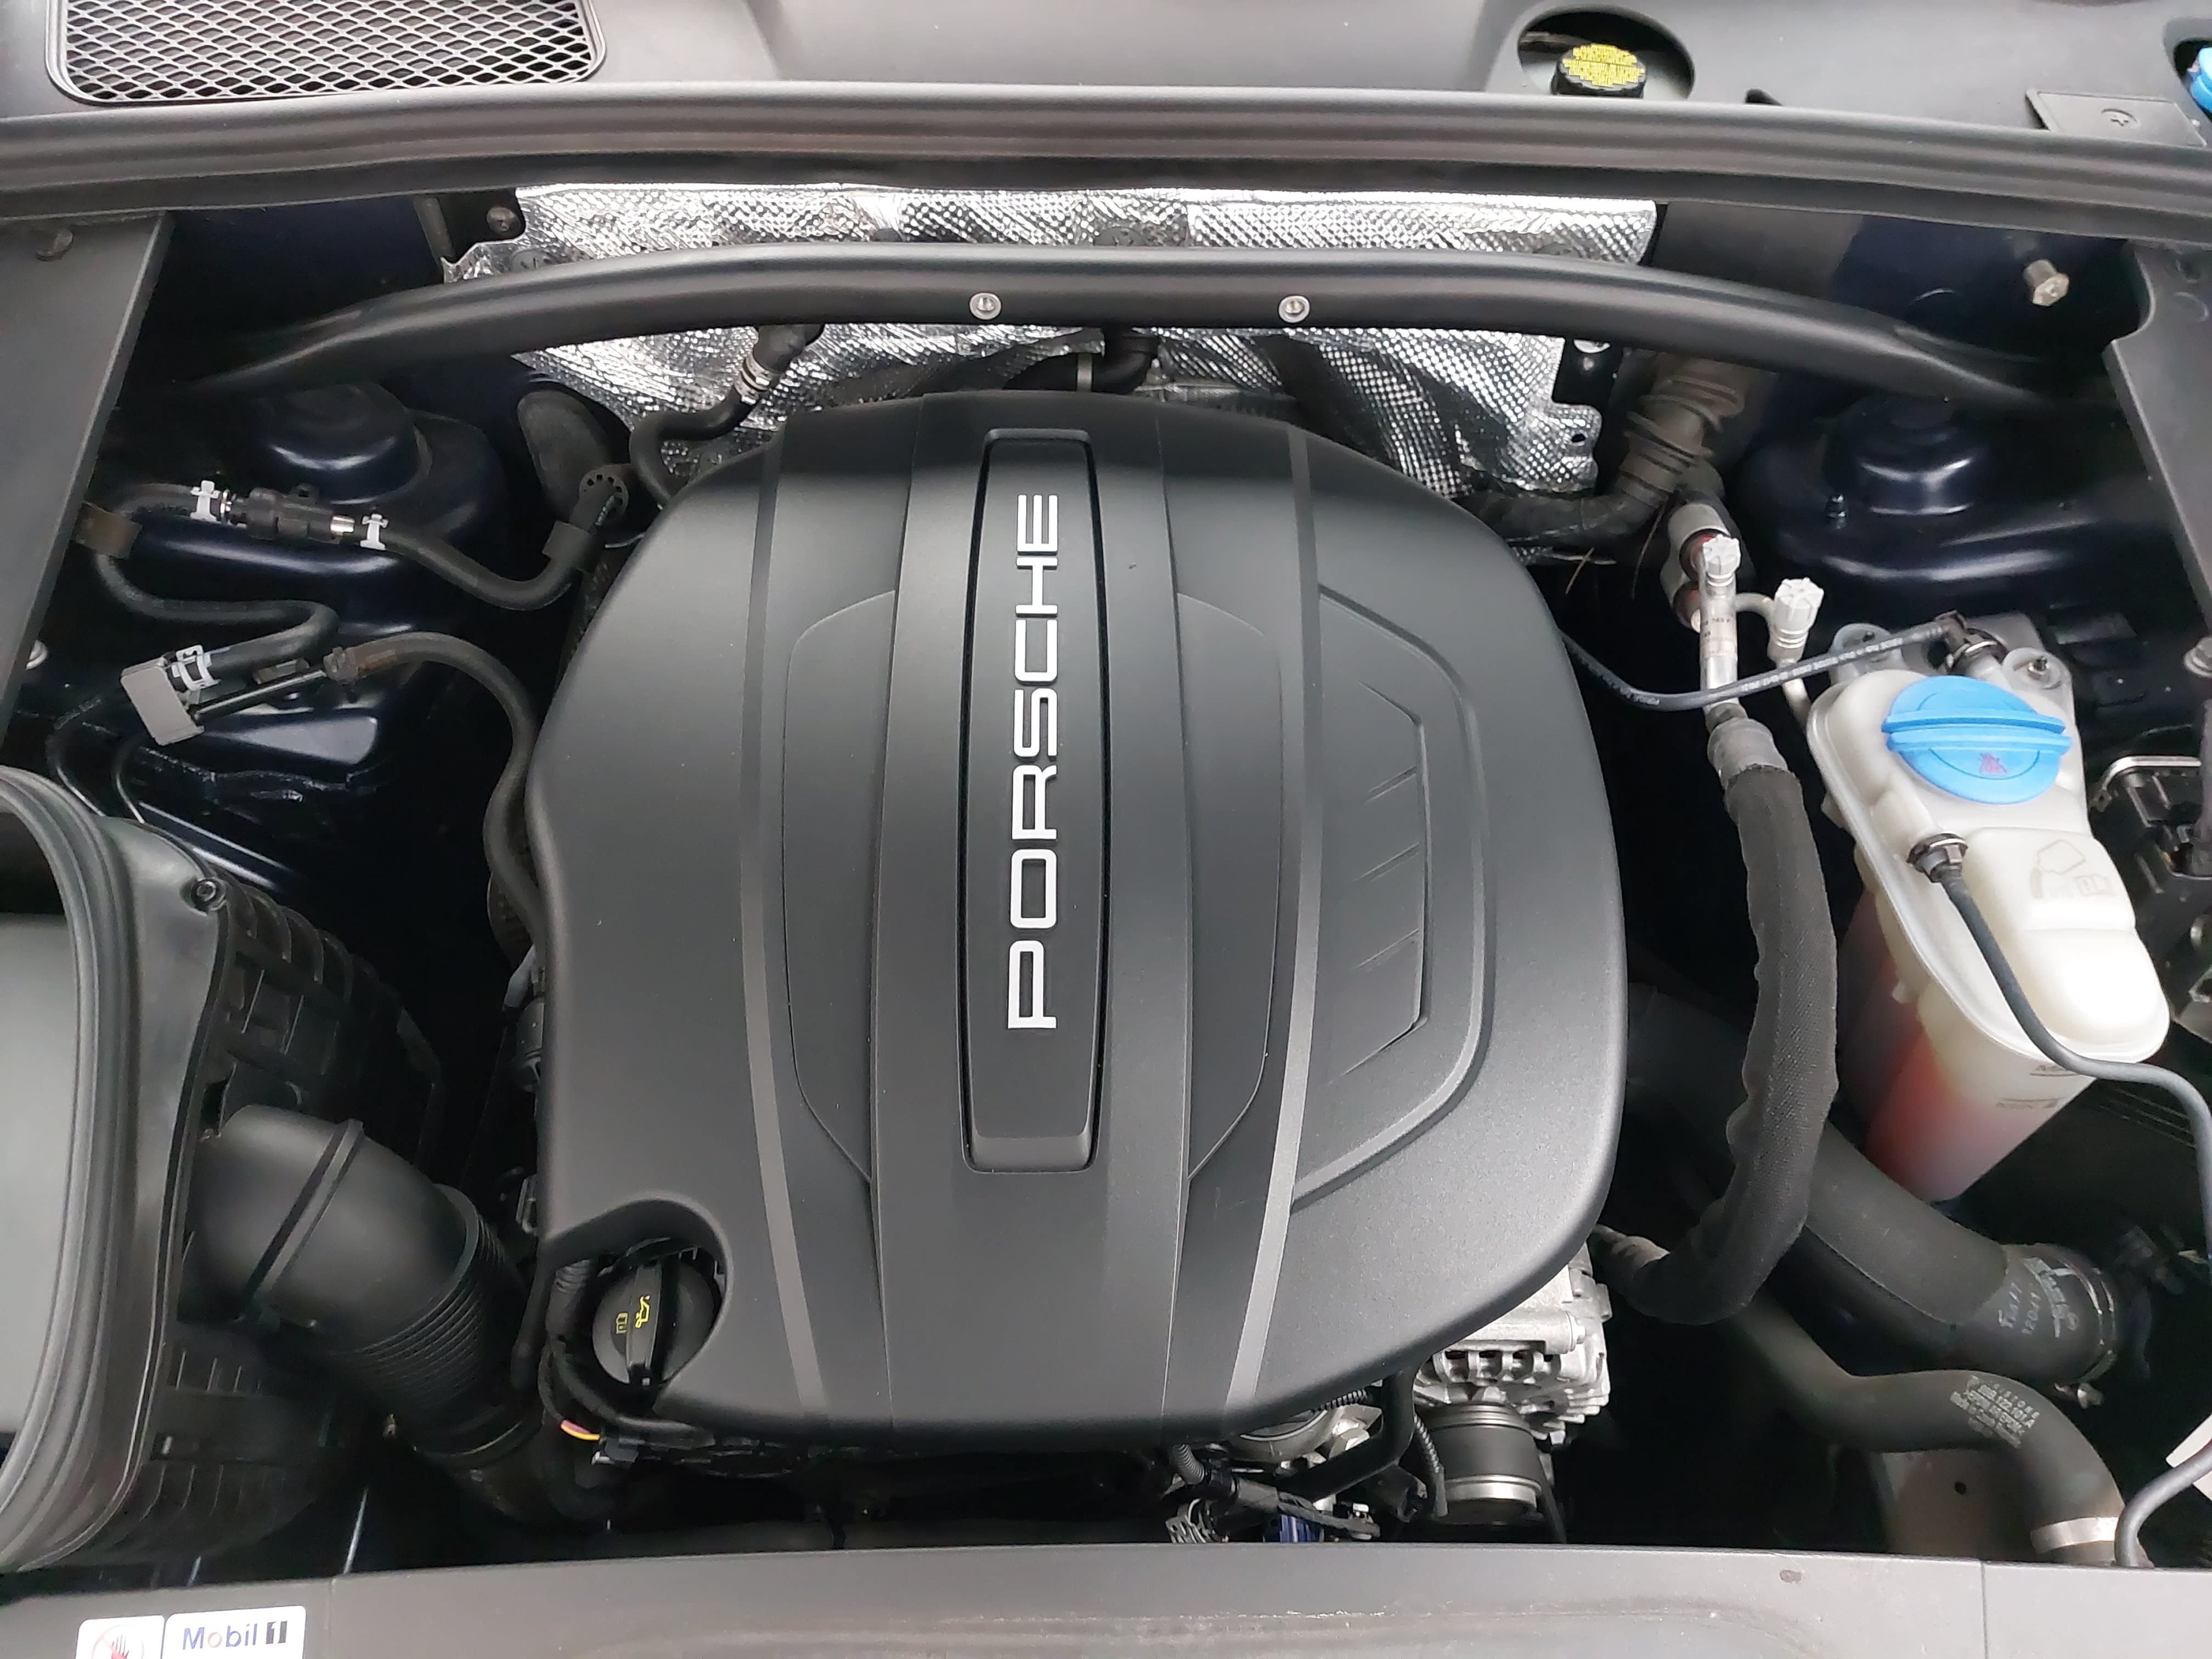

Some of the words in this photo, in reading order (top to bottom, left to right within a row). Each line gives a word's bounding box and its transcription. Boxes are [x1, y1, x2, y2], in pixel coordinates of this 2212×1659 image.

[1006, 494, 1059, 1030] PORSCHE
[182, 1623, 258, 1650] Mobil
[265, 1620, 288, 1645] 1
